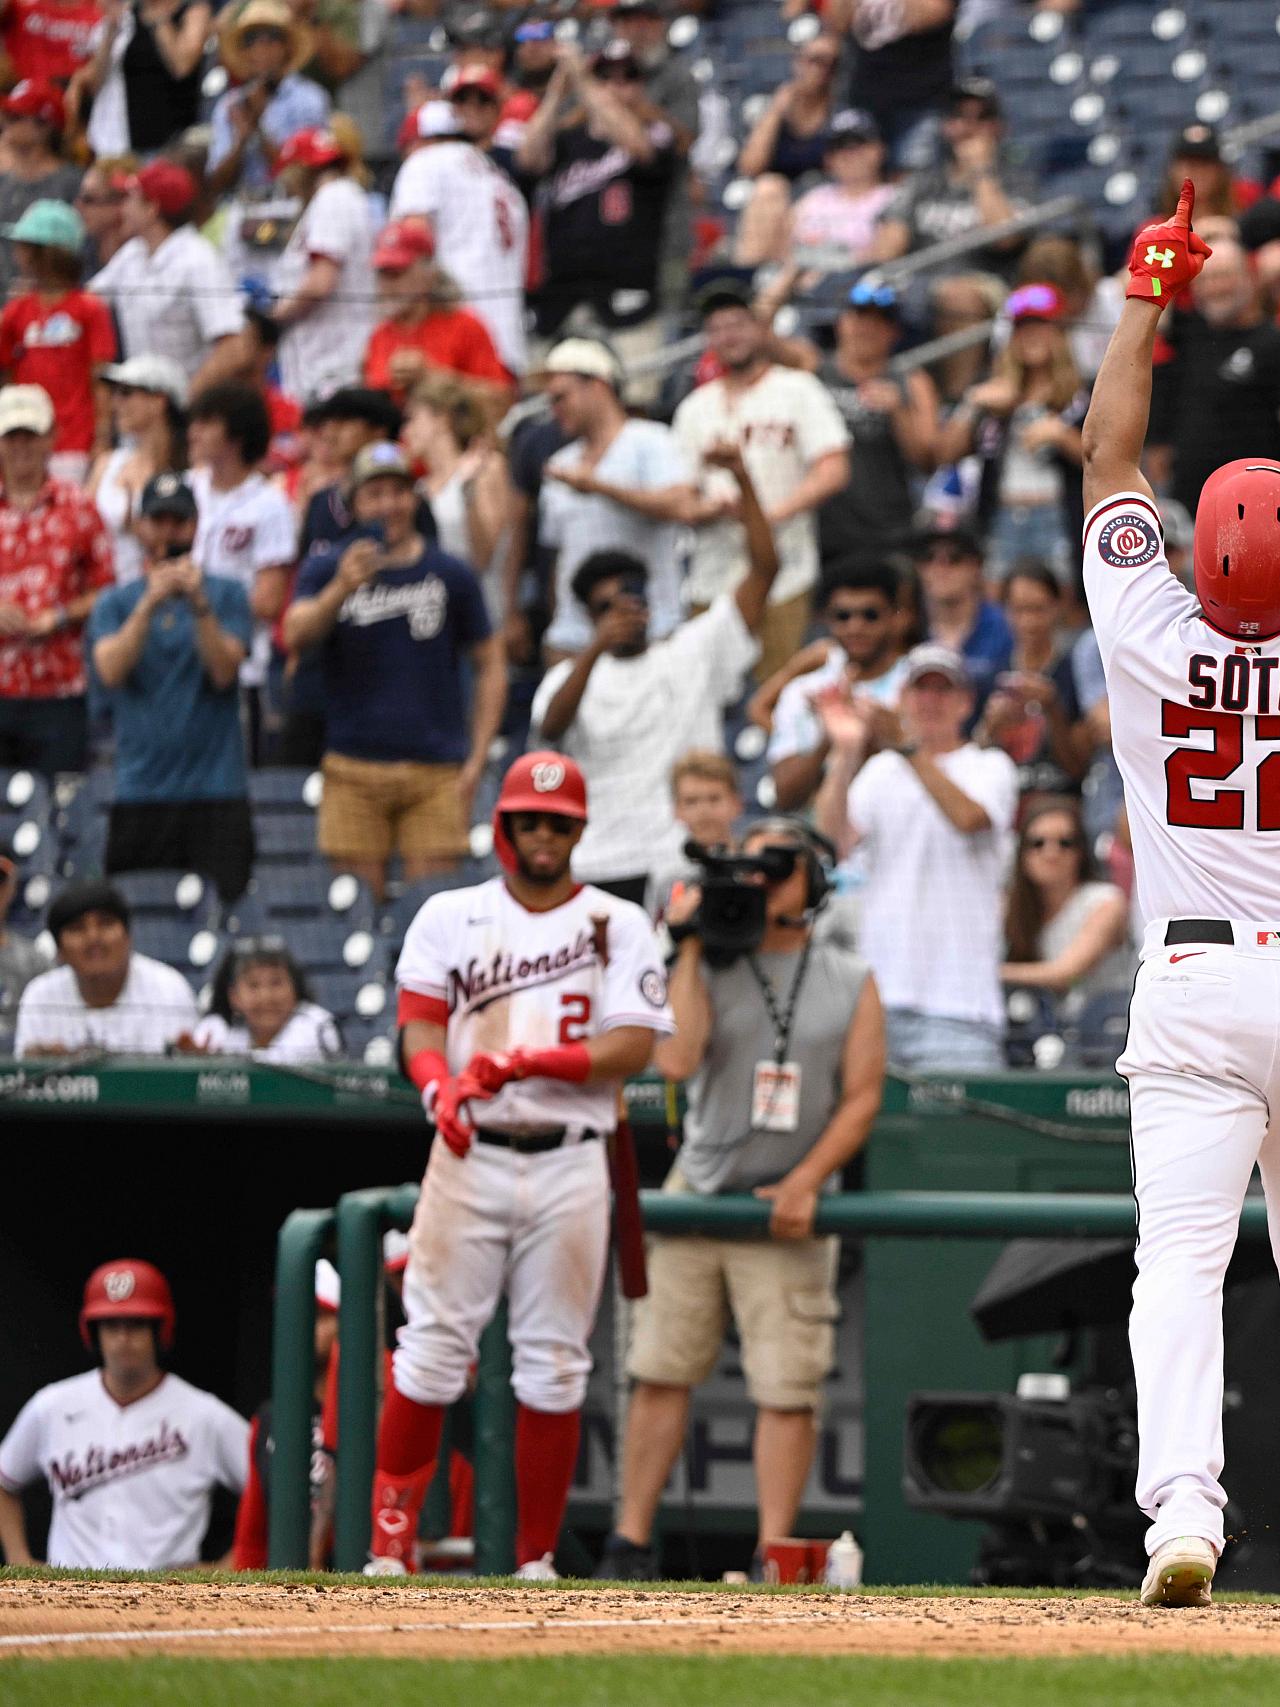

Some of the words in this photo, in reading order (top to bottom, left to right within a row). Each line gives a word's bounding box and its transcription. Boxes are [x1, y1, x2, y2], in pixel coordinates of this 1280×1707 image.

[1101, 517, 1145, 544] NATIONALS
[1107, 540, 1157, 566] WASHINGTON
[531, 761, 565, 792] W
[559, 993, 591, 1045] 2
[51, 1417, 189, 1500] Nationals
